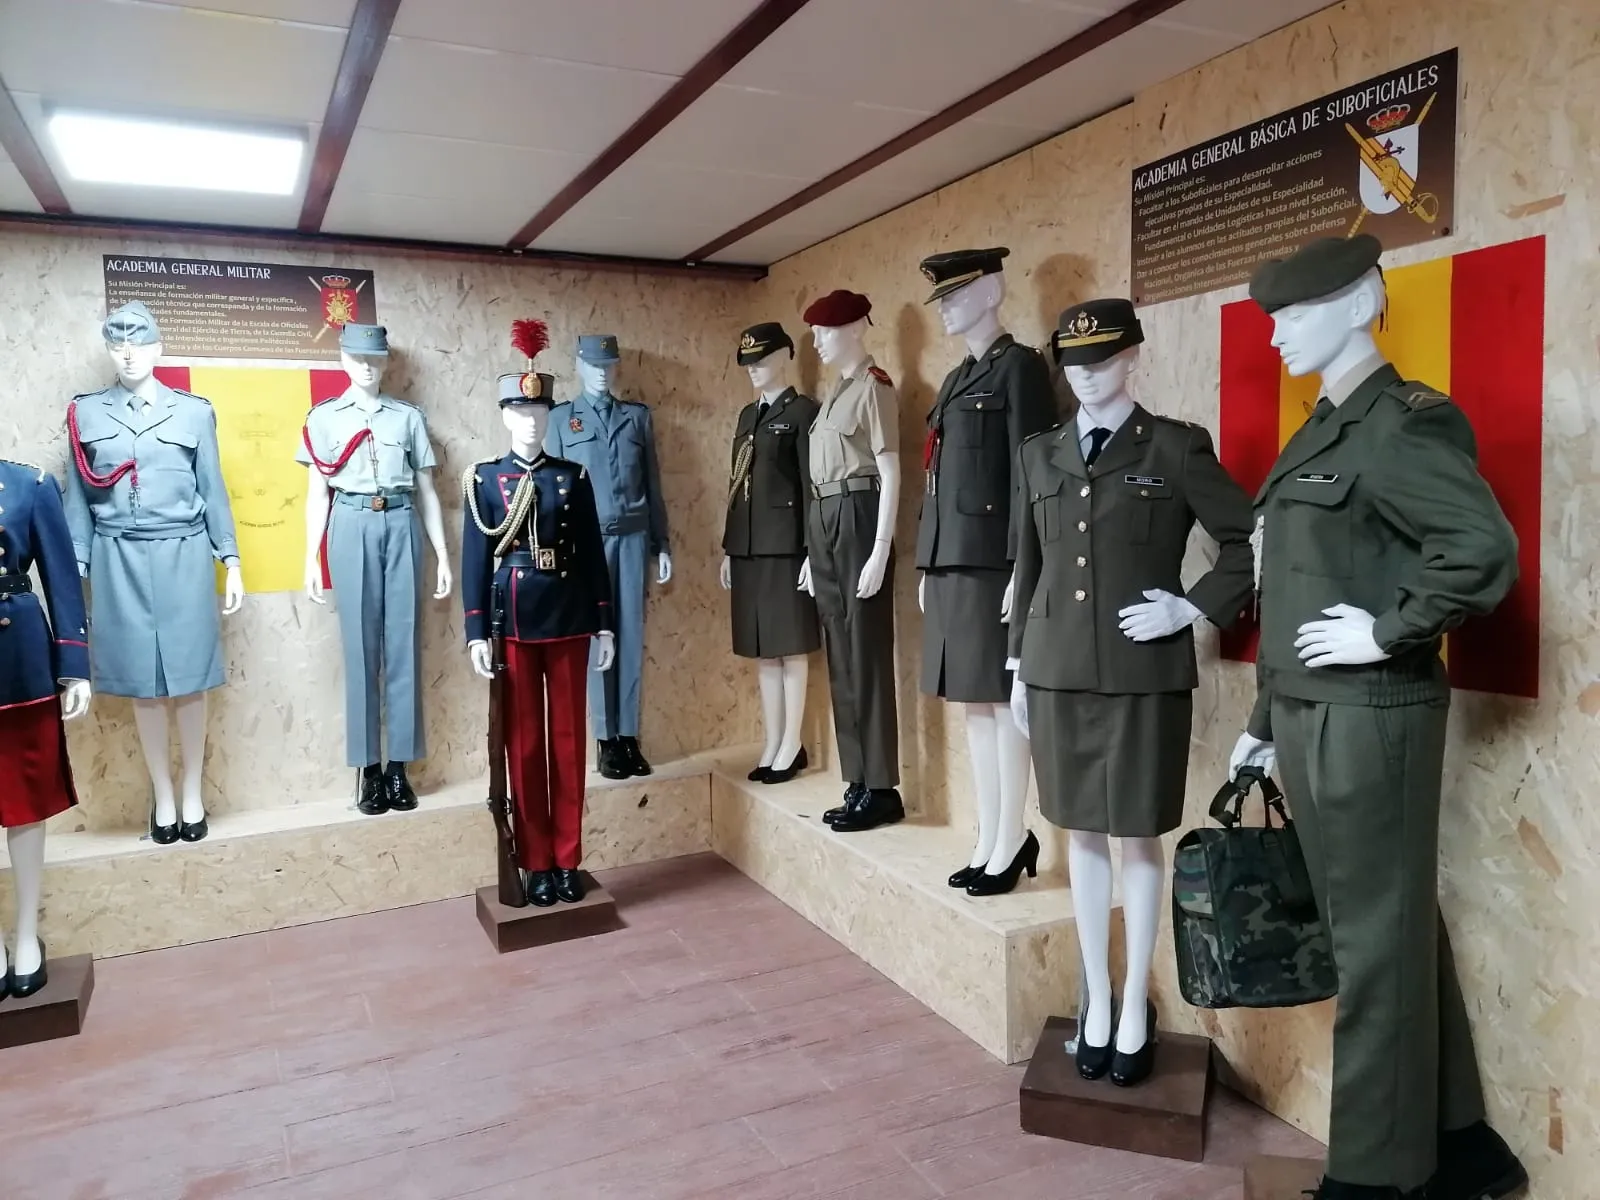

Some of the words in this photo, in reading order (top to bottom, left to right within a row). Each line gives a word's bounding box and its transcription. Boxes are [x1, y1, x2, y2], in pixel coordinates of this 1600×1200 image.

[1134, 156, 1187, 192] ACADEMIA
[1191, 134, 1245, 170] GENERAL
[1250, 109, 1296, 150] BÁSICA
[1302, 106, 1320, 131] DE
[1326, 62, 1438, 123] SUBOFICIALES
[1134, 195, 1142, 206] Su
[1165, 176, 1194, 198] Principal
[1170, 194, 1179, 205] los
[1181, 179, 1222, 202] Suboficiales
[1224, 175, 1240, 190] para
[1241, 158, 1284, 182] desarrollar
[1286, 146, 1322, 168] acciones
[1163, 225, 1171, 234] en
[1172, 220, 1178, 230] el
[1204, 209, 1213, 220] de
[1215, 198, 1248, 218] Unidades
[1250, 194, 1260, 207] de
[1261, 194, 1270, 203] su
[1272, 175, 1323, 202] Especialidad
[1193, 219, 1225, 237] Unidades
[1266, 200, 1287, 216] hasta
[1289, 194, 1309, 209] nivel
[1311, 183, 1347, 204] Sección.
[1203, 197, 1212, 208] de
[1206, 238, 1215, 247] en
[1264, 214, 1293, 233] propias
[1296, 209, 1309, 222] del
[1244, 231, 1283, 252] generales
[1284, 224, 1308, 240] sobre
[1310, 214, 1346, 234] Defensa
[106, 258, 166, 274] ACADEMIA
[171, 262, 222, 276] GENERAL
[227, 265, 270, 279] MILITAR
[144, 281, 174, 290] Principal
